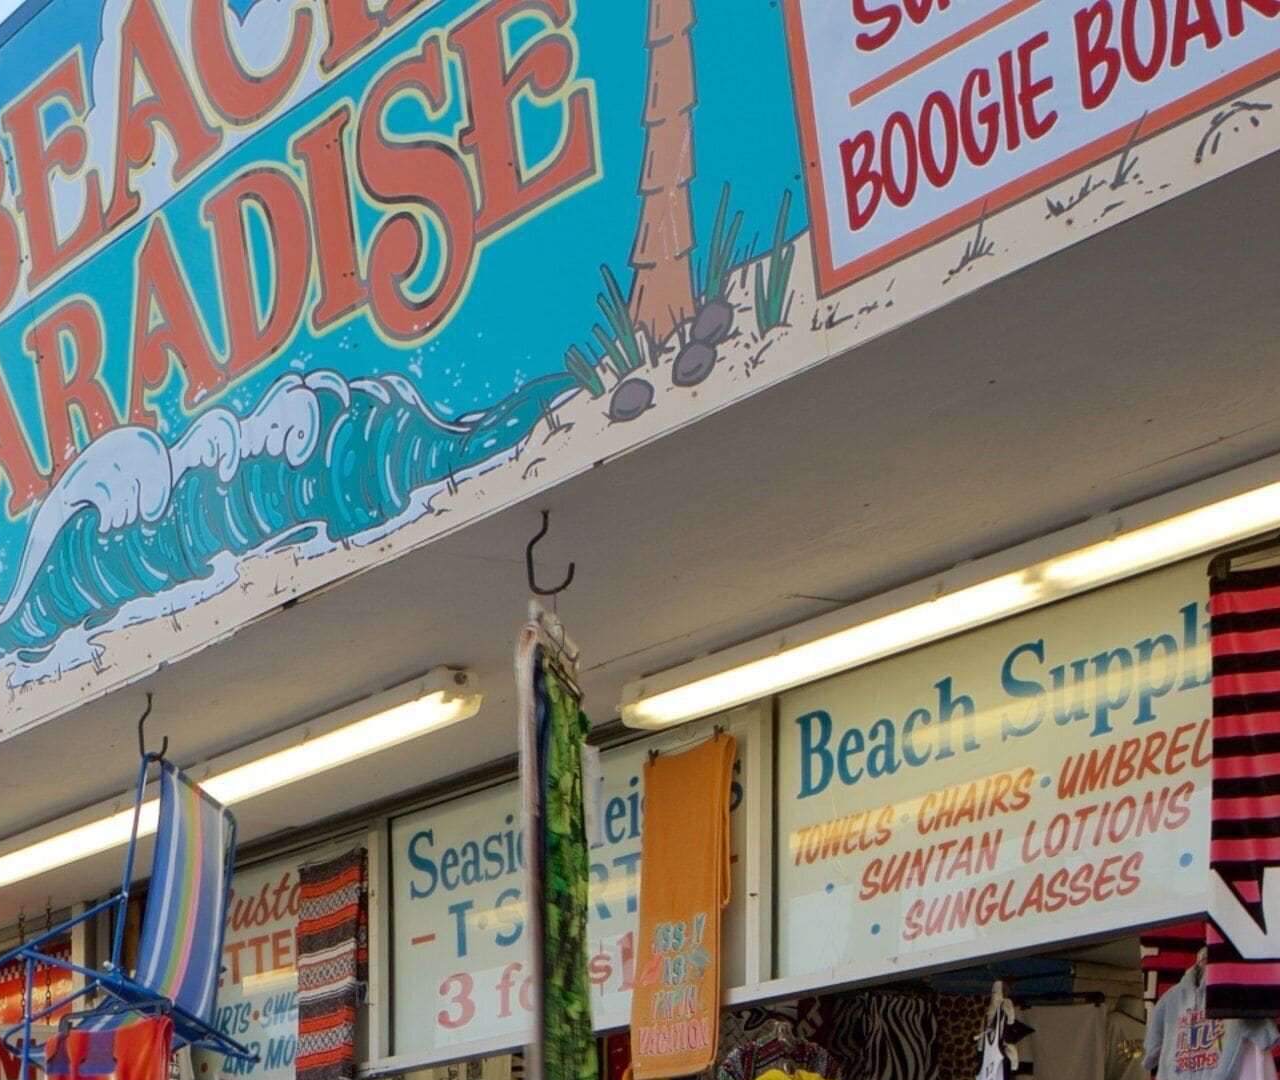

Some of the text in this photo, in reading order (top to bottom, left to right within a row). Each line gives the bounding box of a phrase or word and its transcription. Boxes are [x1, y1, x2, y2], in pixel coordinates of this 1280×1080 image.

[839, 31, 1058, 231] BOOGIE
[796, 676, 981, 800] Beach
[795, 807, 893, 866] TOWELS
[917, 769, 1035, 836] CHAIRS
[859, 781, 1195, 901] SUNTAN LOTIONS
[902, 853, 1144, 942] SUNGLASSES
[439, 972, 476, 1029] 3
